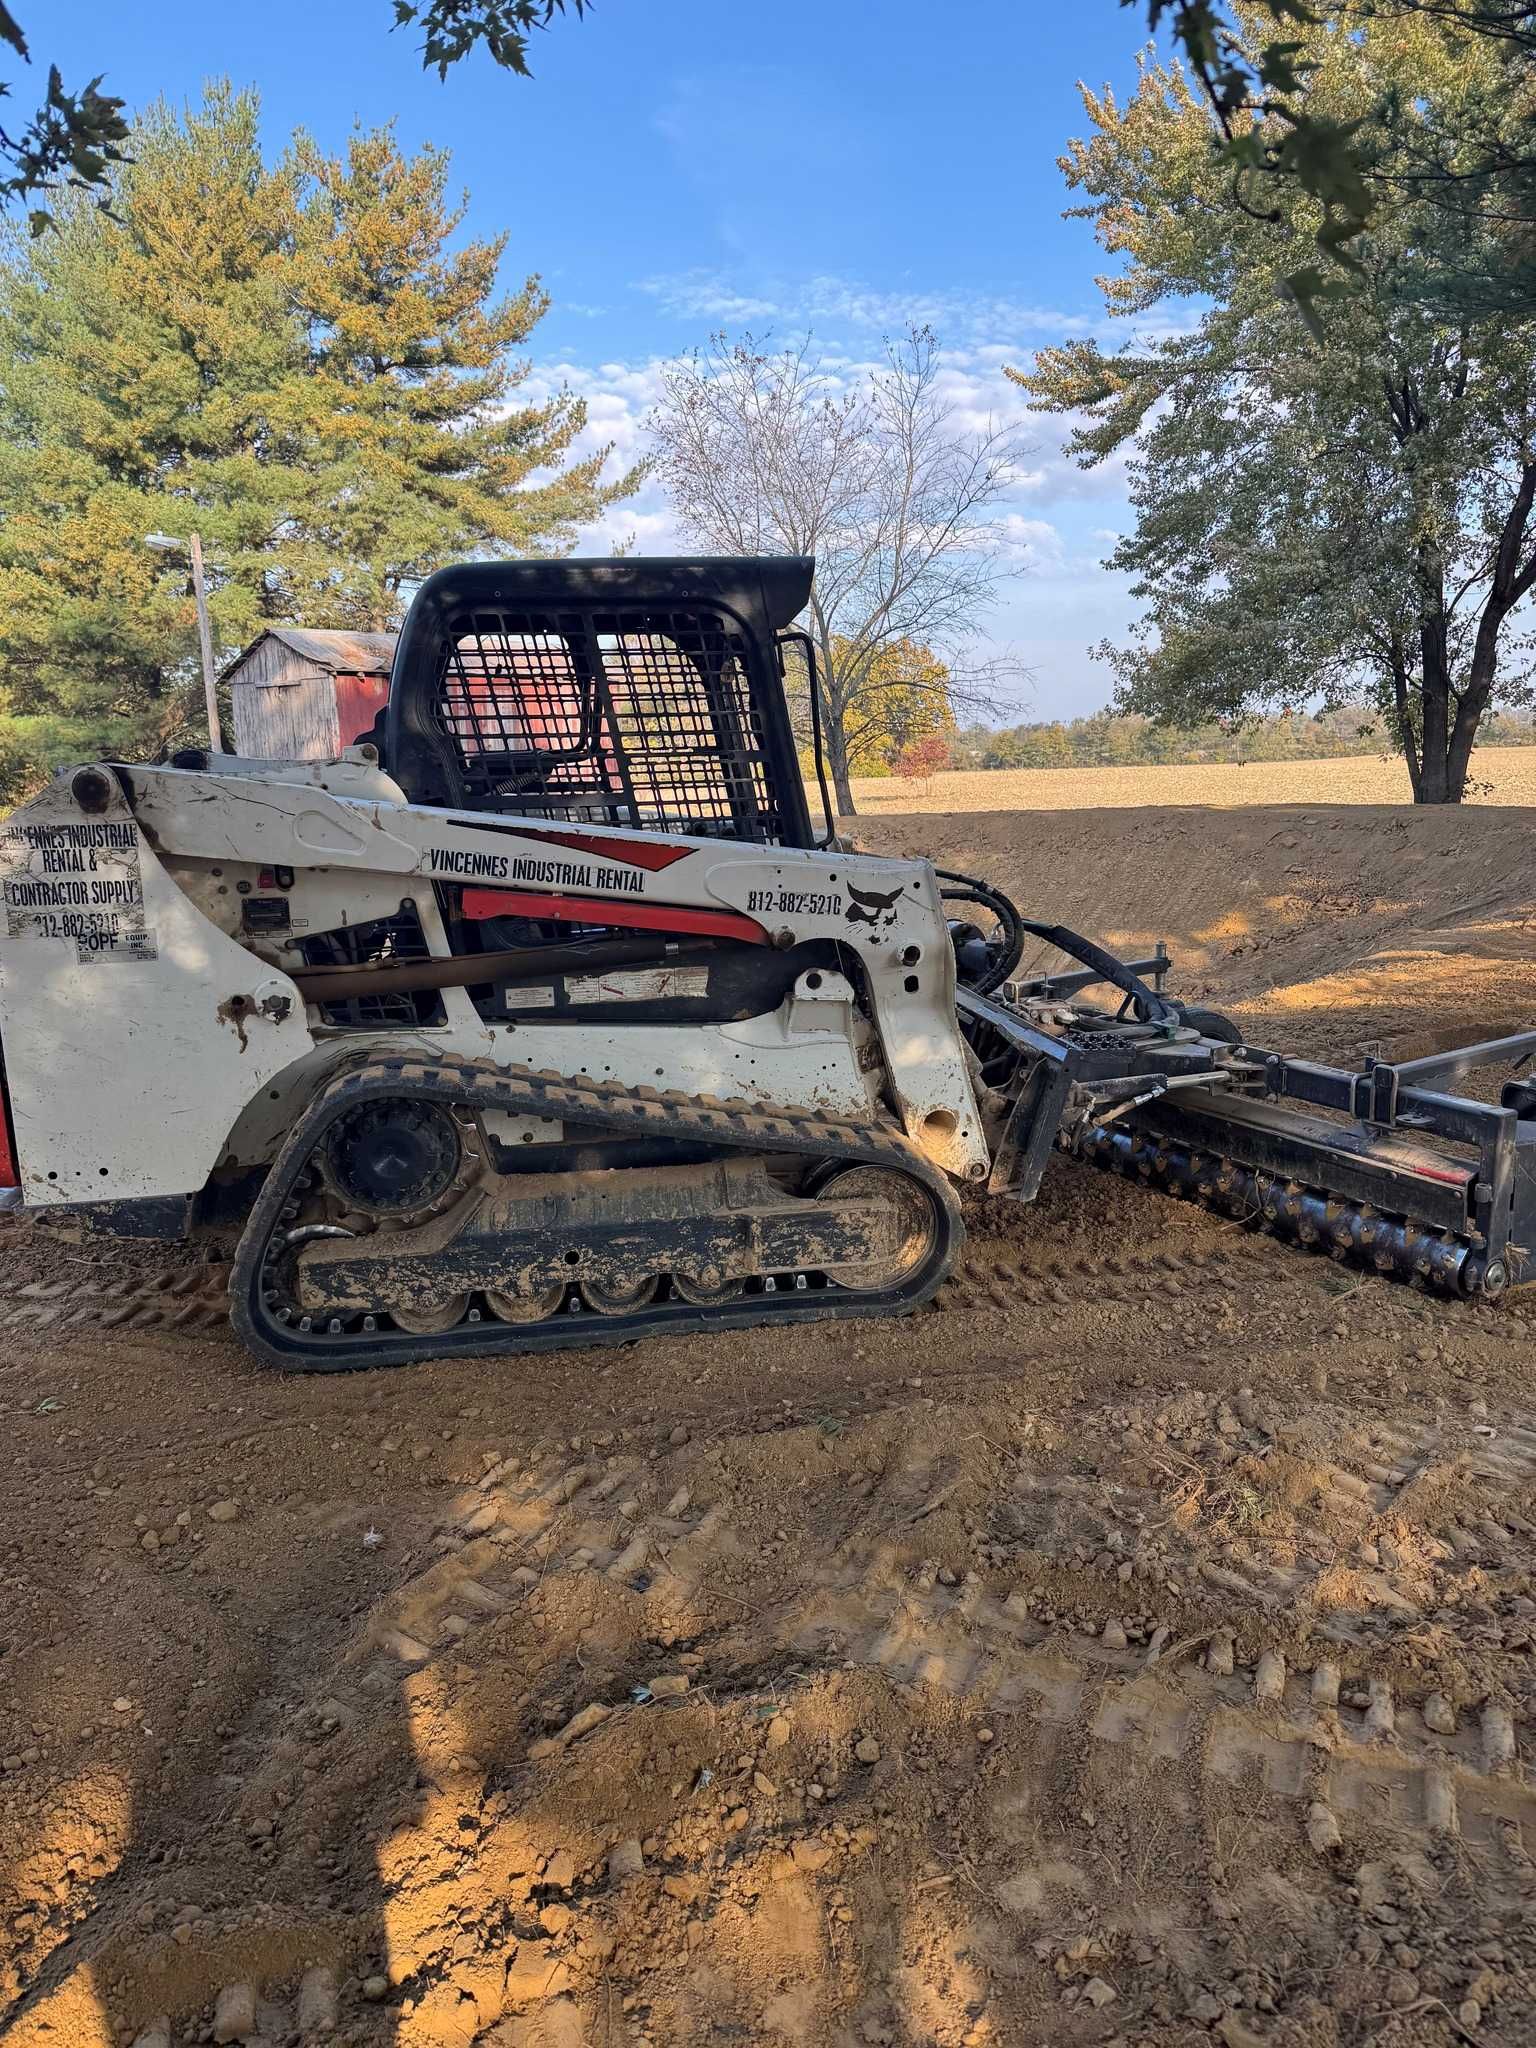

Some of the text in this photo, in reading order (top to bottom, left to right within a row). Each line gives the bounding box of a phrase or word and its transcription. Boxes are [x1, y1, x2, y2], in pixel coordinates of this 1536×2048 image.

[8, 823, 137, 849] ENNES INDUSTRIAL
[43, 848, 98, 873] RENTAL &
[430, 848, 645, 893] VINCENNES INDUSTRIAL RENTAL
[11, 879, 135, 907] CONTRACTOR SUPPLY
[748, 890, 841, 916] 812-882-5210
